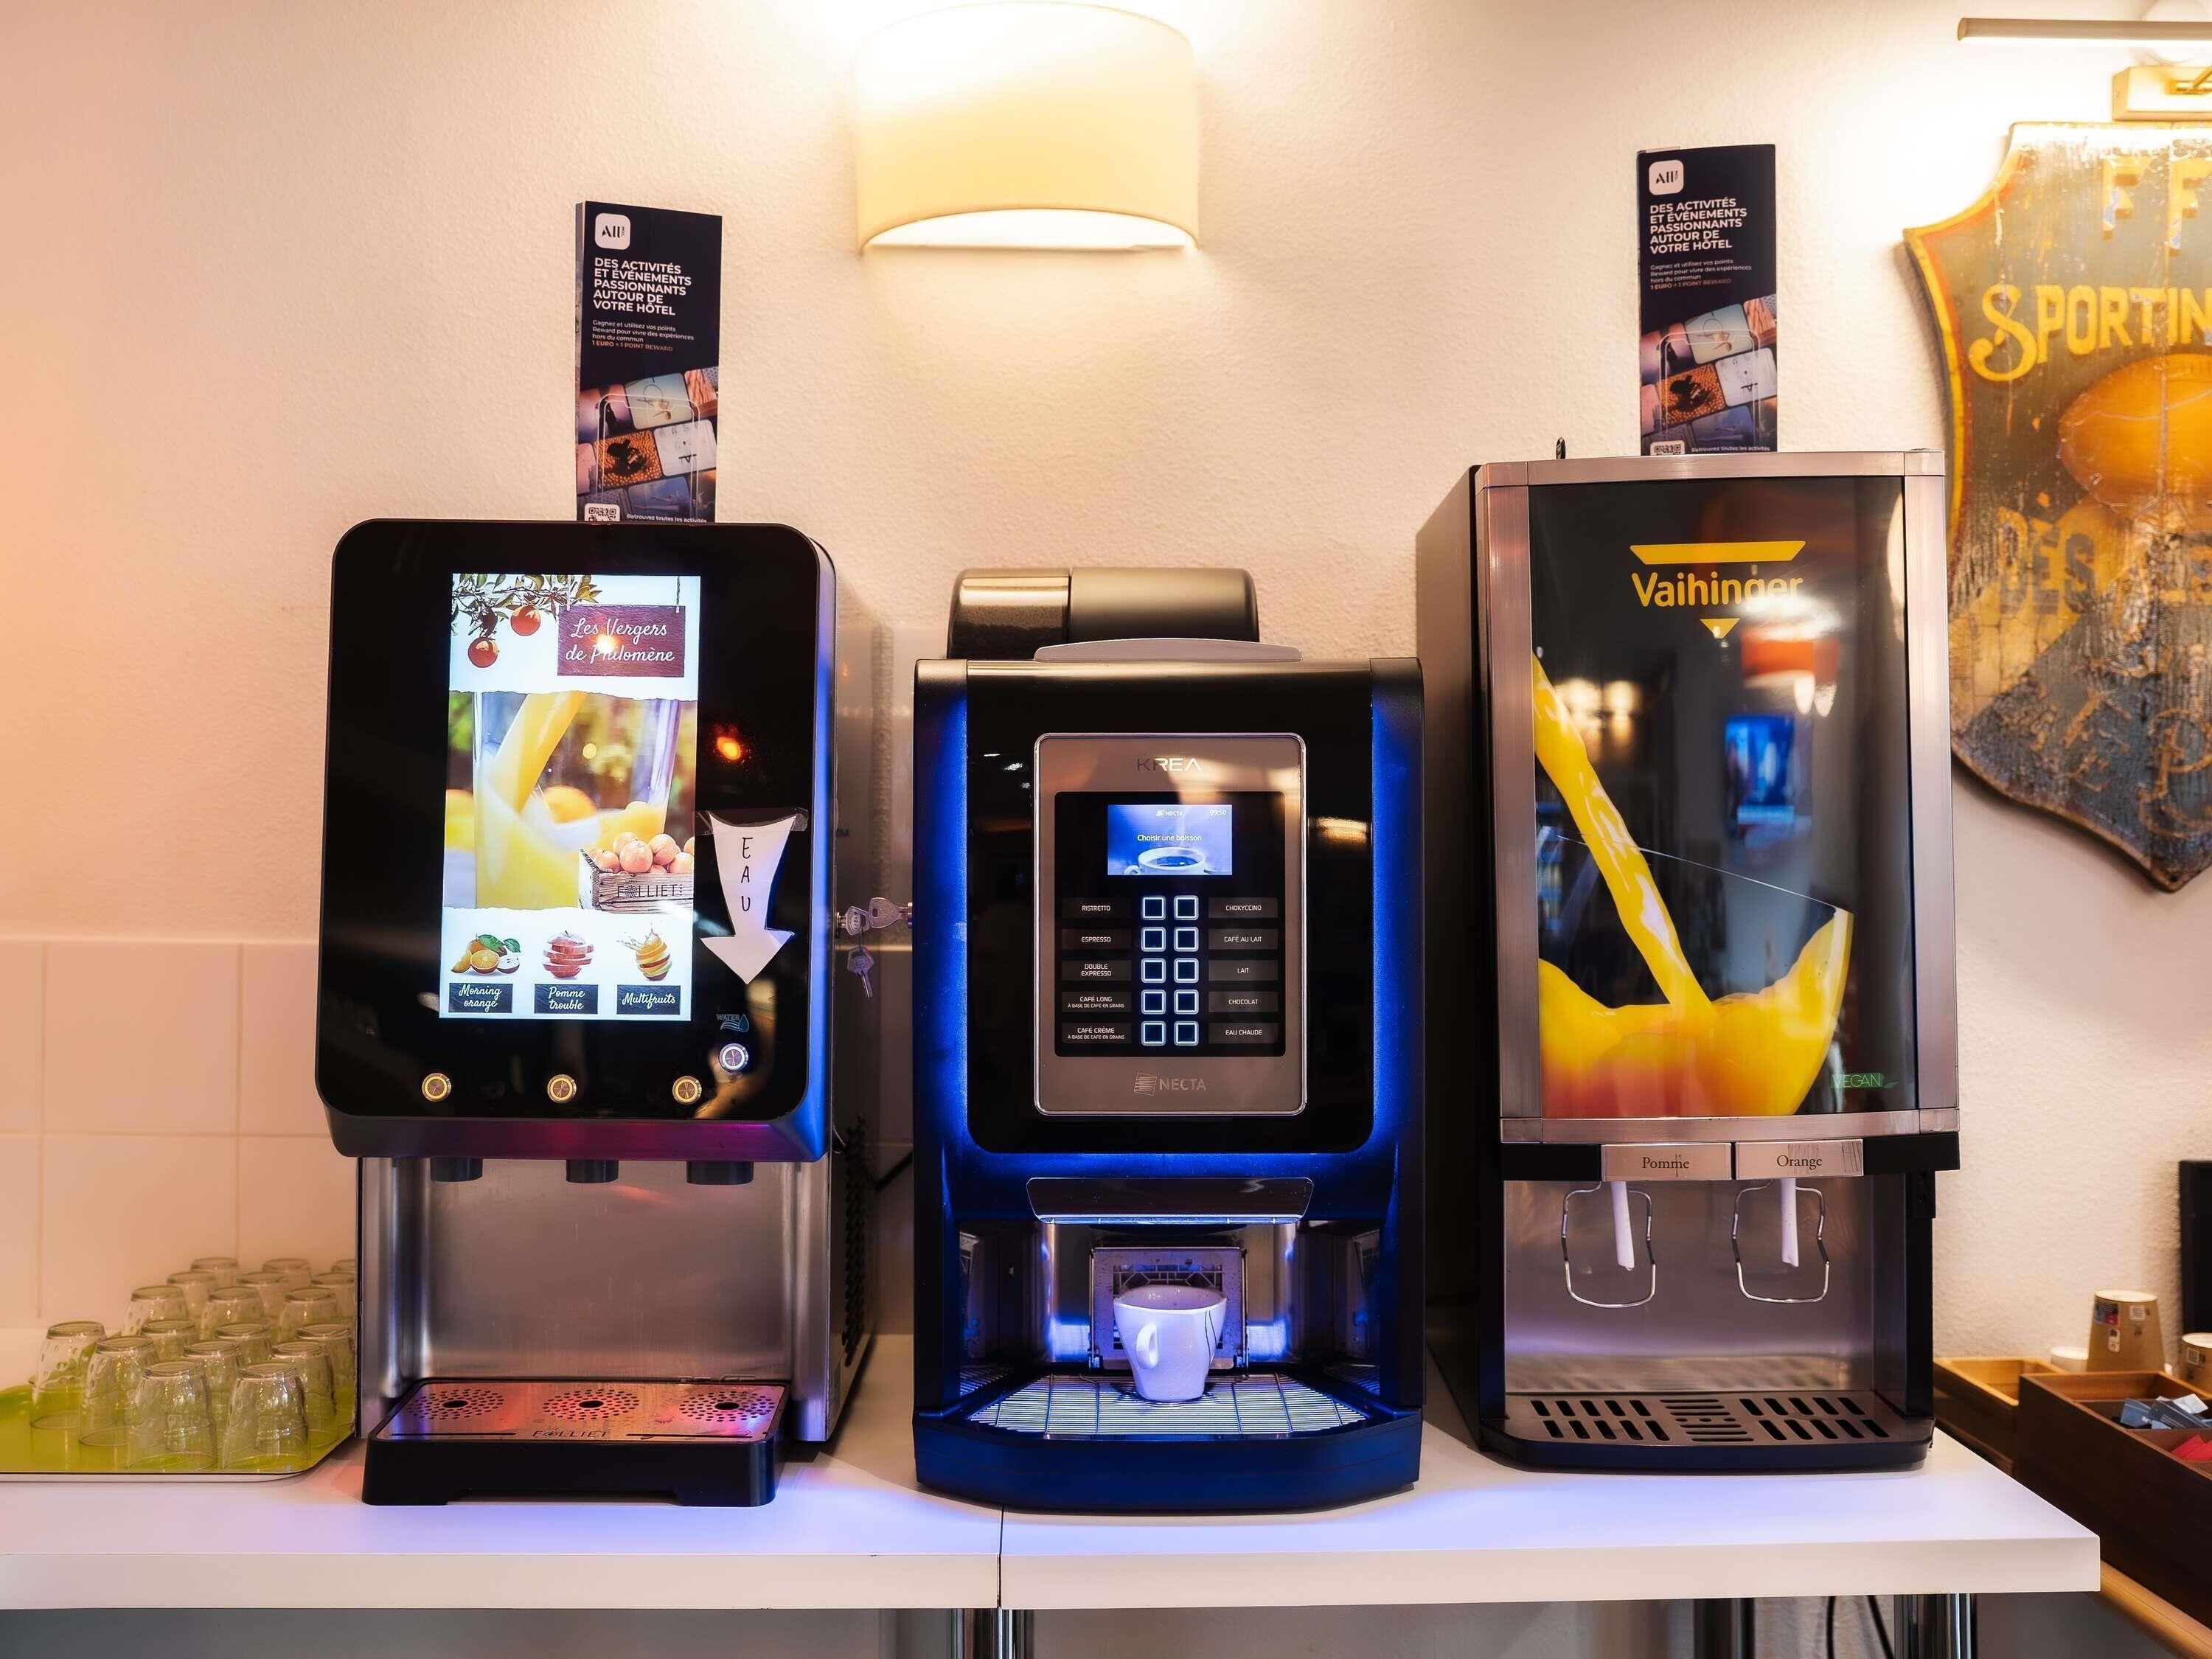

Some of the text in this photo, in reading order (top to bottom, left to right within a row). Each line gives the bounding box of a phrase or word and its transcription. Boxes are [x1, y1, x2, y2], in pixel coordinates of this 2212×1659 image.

[1650, 197, 1736, 214] DES ACTIVITÉS
[1650, 208, 1747, 224] ET ÉVÉNEMENTS
[1650, 218, 1742, 234] PASSIONNANTS
[1650, 230, 1719, 245] AUTOUR DE
[1650, 240, 1733, 254] VOTRE HÔTEL
[594, 258, 681, 274] DES ACTIVITÉS
[594, 268, 692, 285] ET ÉVÉNEMENTS
[594, 280, 686, 295] PASSIONNANTS
[594, 289, 664, 304] AUTOUR DE
[594, 299, 675, 316] VOTRE HÔTEL
[571, 618, 667, 644] Les Vergers
[565, 644, 586, 661] de
[1137, 758, 1203, 771] KREA
[741, 837, 754, 911] EAU
[459, 984, 503, 1000] Morning
[549, 987, 585, 998] Pomme
[463, 997, 498, 1012] orange
[549, 999, 584, 1010] trouble
[622, 993, 675, 1009] Multifruits
[1159, 1078, 1206, 1091] NECTA
[1832, 1074, 1881, 1088] VEGAN
[1641, 1157, 1690, 1169] Pomme
[1777, 1155, 1823, 1170] Orange
